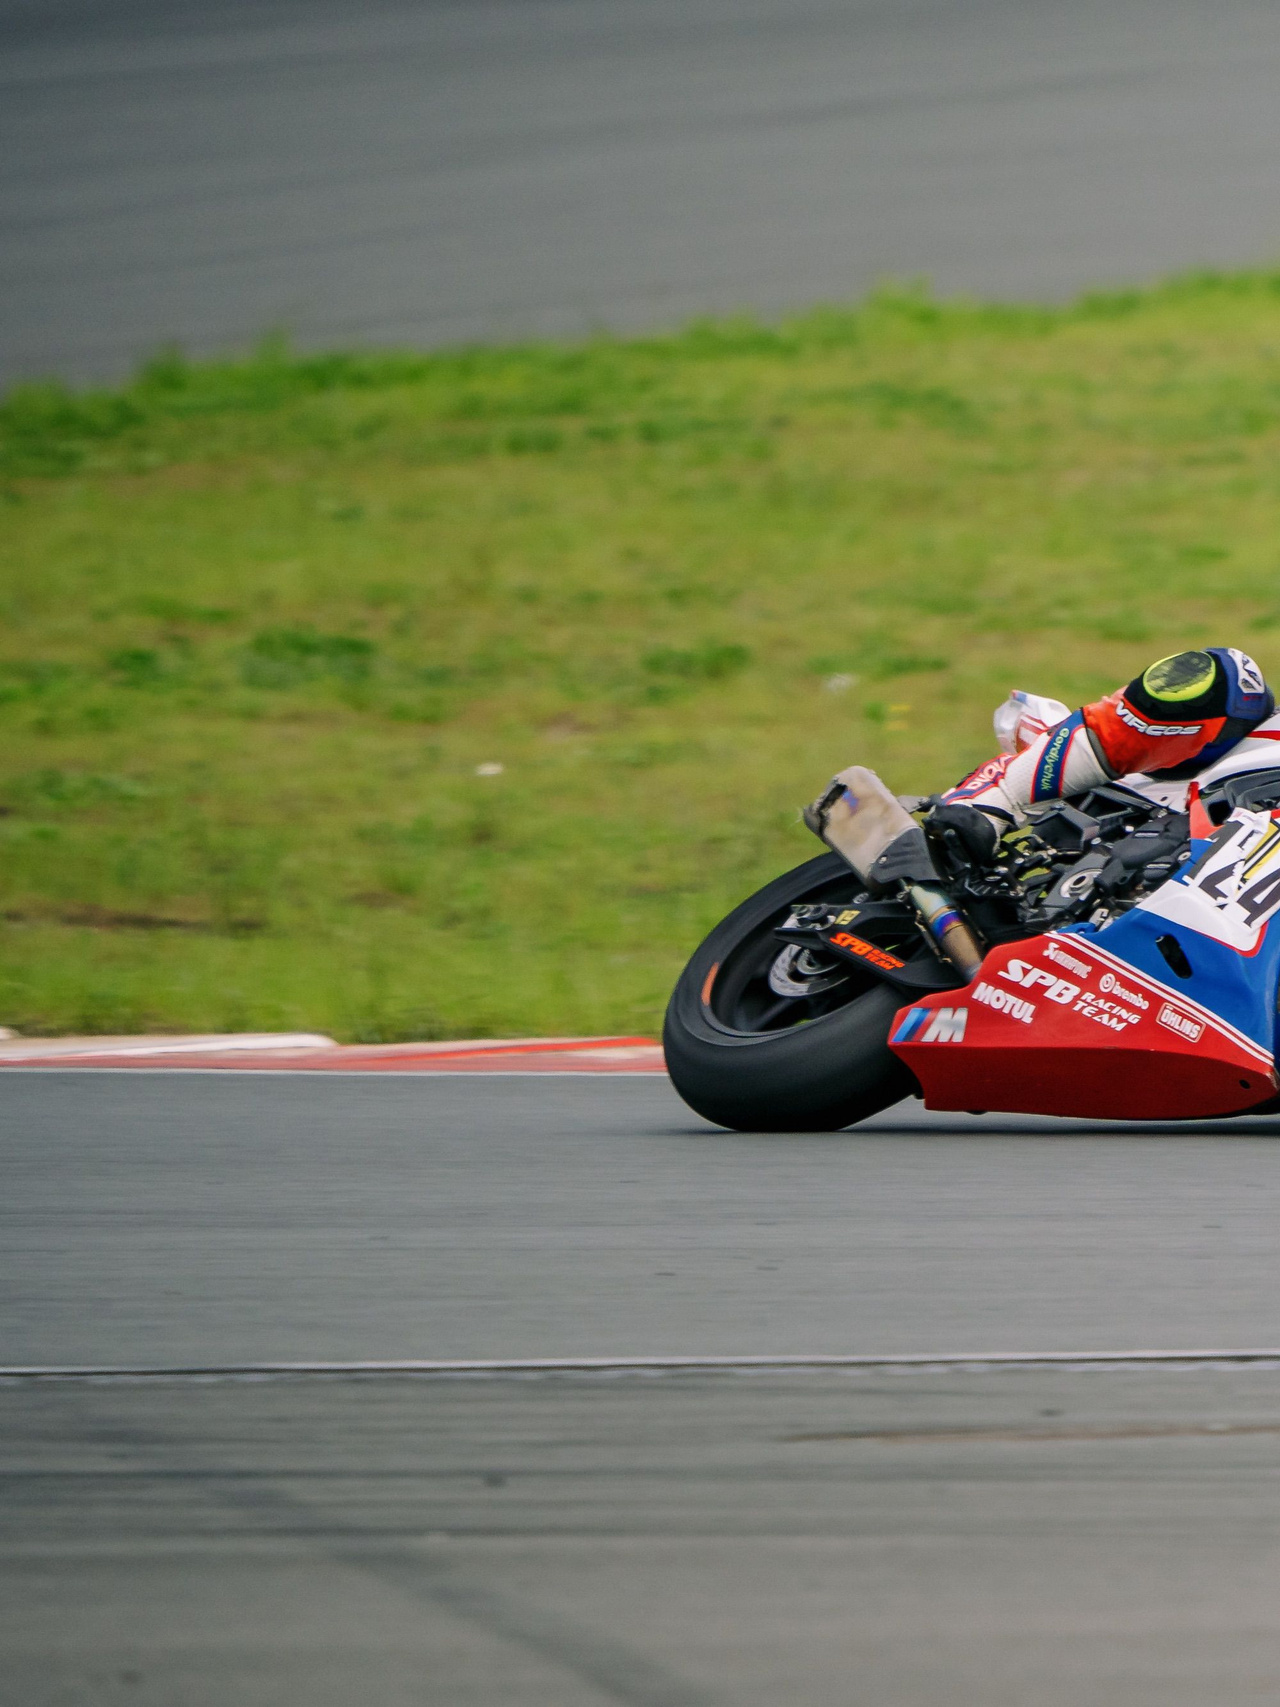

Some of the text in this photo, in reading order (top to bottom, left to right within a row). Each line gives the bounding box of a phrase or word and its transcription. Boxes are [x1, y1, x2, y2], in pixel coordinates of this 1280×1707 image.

[1116, 701, 1203, 736] VIRCOS
[829, 932, 874, 956] SPB
[971, 981, 1037, 1024] MOTUL
[997, 959, 1142, 1025] SPB RACING
[1111, 981, 1149, 1010] brembo
[1072, 1000, 1128, 1032] TEAM
[1160, 1005, 1201, 1039] ÖHLINS
